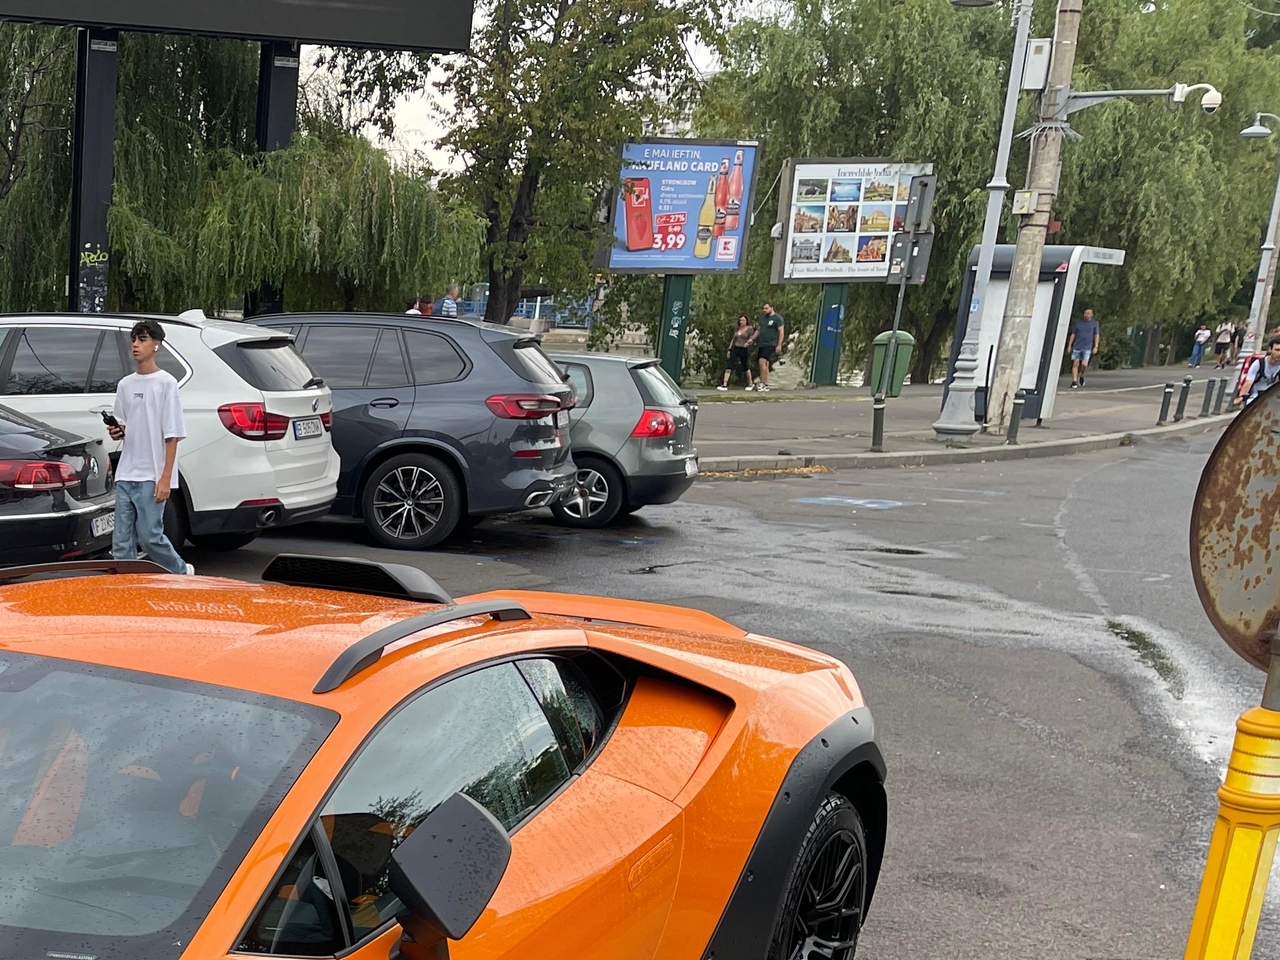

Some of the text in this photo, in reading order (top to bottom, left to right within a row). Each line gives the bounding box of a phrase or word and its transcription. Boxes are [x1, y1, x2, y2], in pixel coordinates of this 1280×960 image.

[644, 148, 702, 161] E MAI IEFTIN,
[690, 161, 719, 172] CARD
[837, 167, 872, 178] Incredible
[652, 233, 686, 251] 3,99
